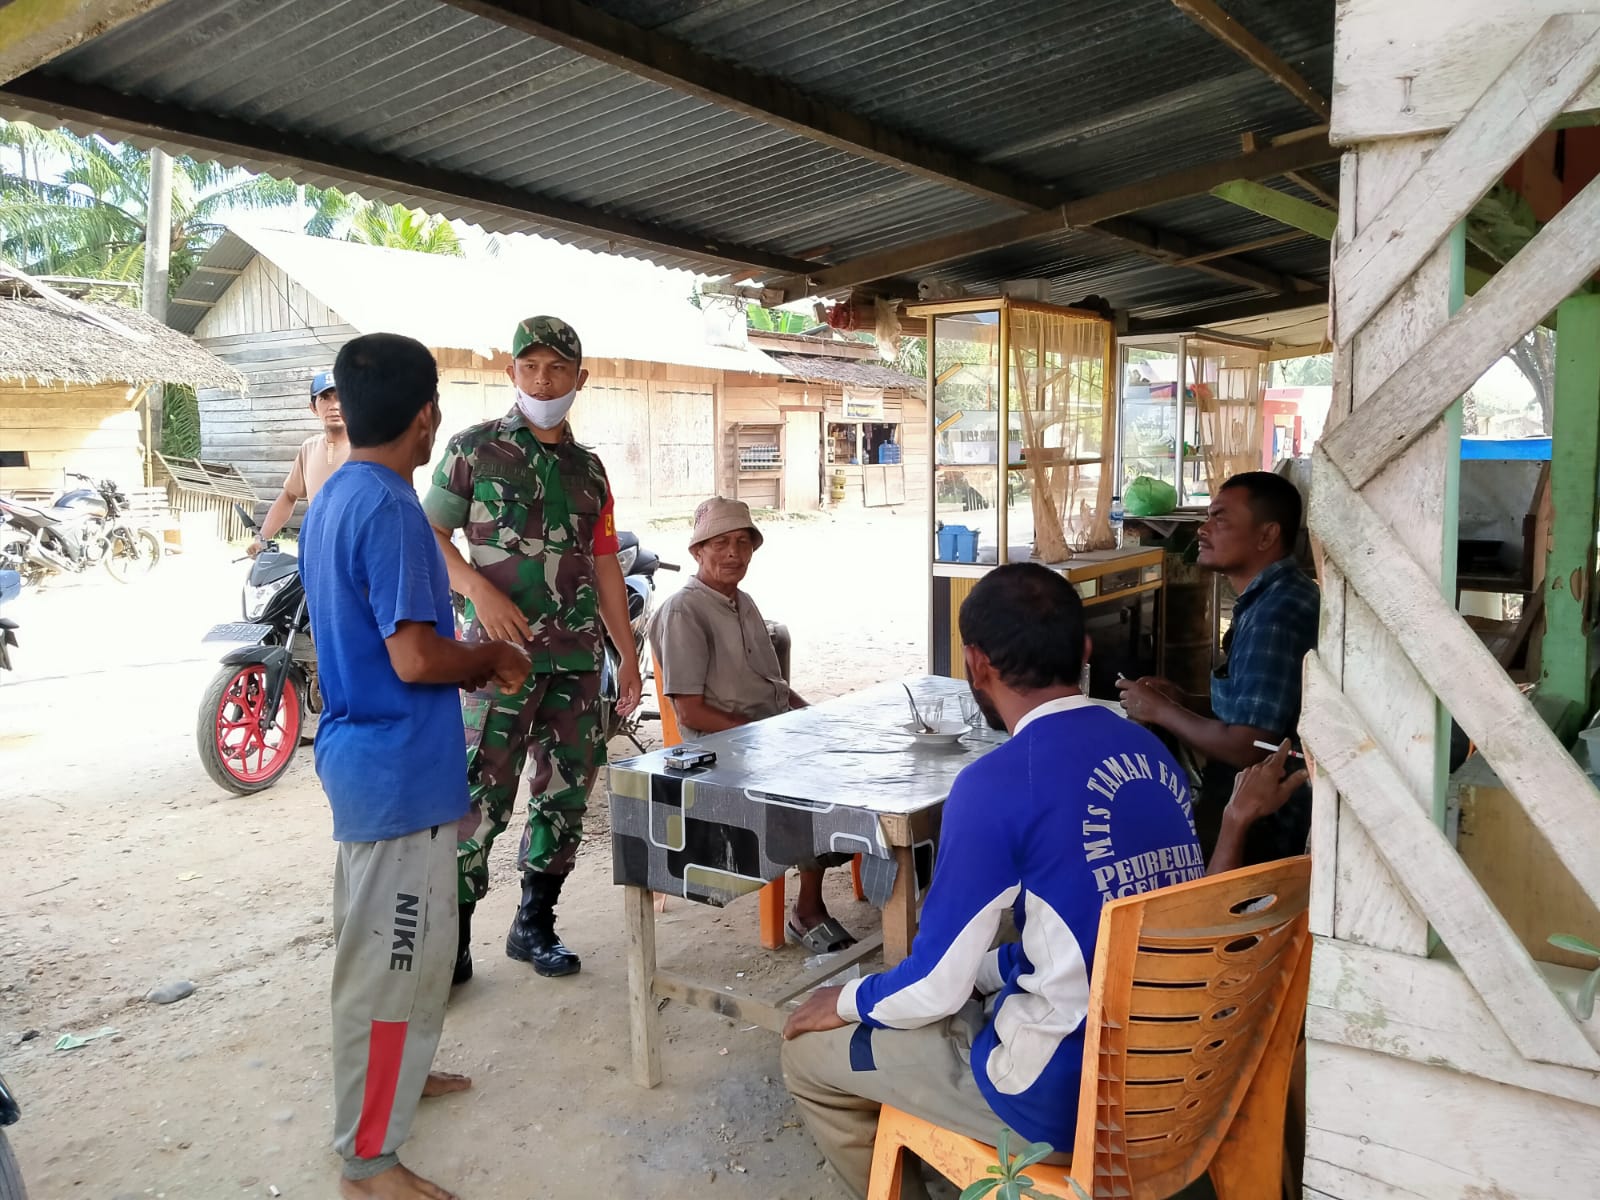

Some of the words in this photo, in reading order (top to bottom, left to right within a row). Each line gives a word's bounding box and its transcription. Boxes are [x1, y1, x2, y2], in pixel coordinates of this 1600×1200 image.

[1086, 753, 1153, 802] TAMAN
[1083, 804, 1115, 863] MTS
[1092, 843, 1204, 892] PEUREULA
[389, 892, 419, 972] NIKE
